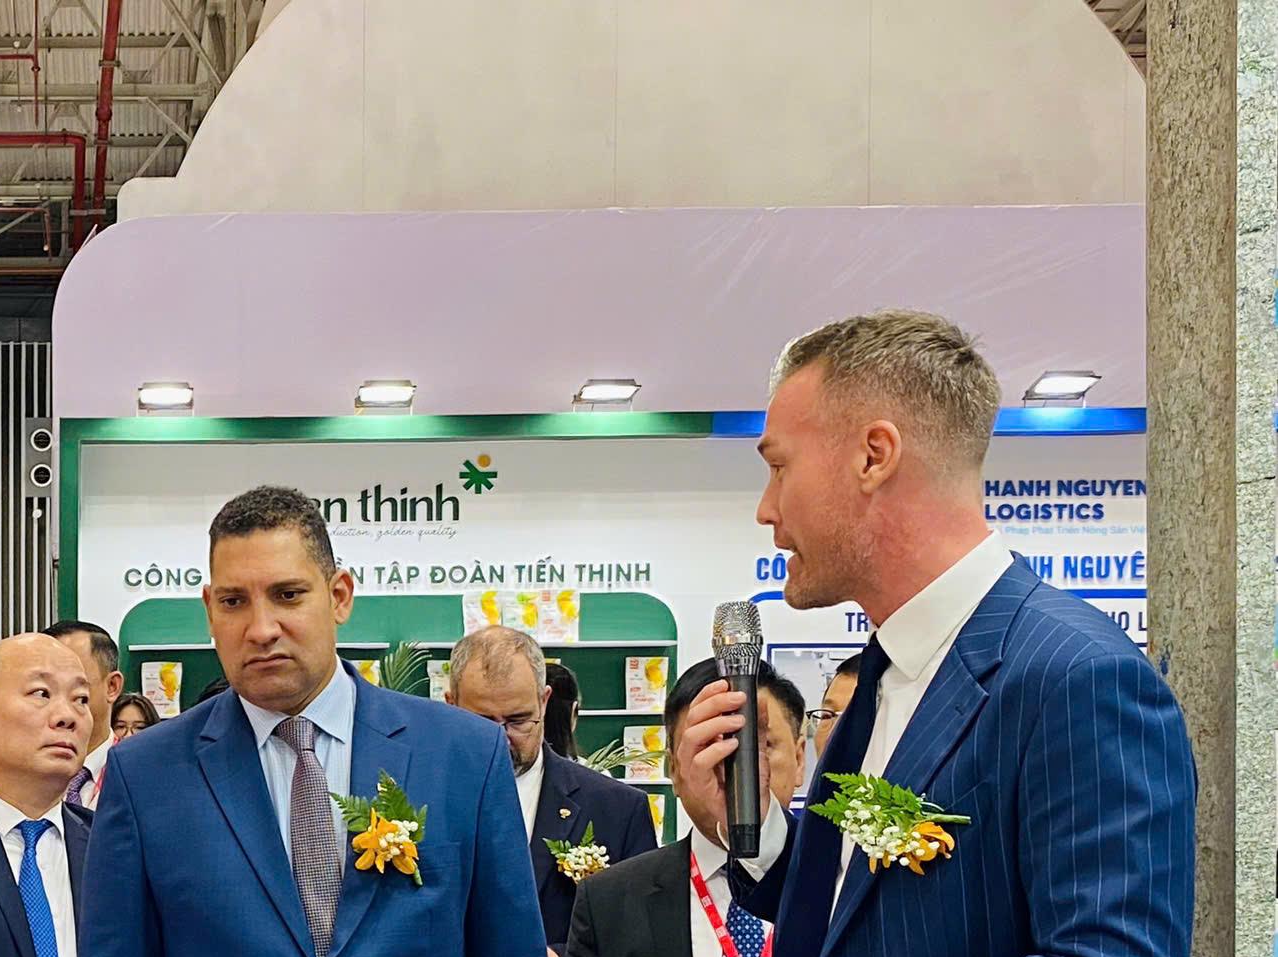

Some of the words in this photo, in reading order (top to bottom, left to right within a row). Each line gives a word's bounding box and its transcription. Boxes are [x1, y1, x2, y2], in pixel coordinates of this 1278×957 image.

[357, 482, 460, 522] thinh
[984, 479, 1051, 497] HANH
[984, 503, 1105, 520] LOGISTICS
[124, 563, 203, 587] CÔNG
[374, 560, 420, 590] TẬP
[429, 559, 505, 584] ĐOÀN
[514, 555, 565, 583] TIẾN
[575, 562, 651, 588] THỊNH
[756, 552, 787, 581] CÔ
[1063, 550, 1146, 579] NGUYÊ
